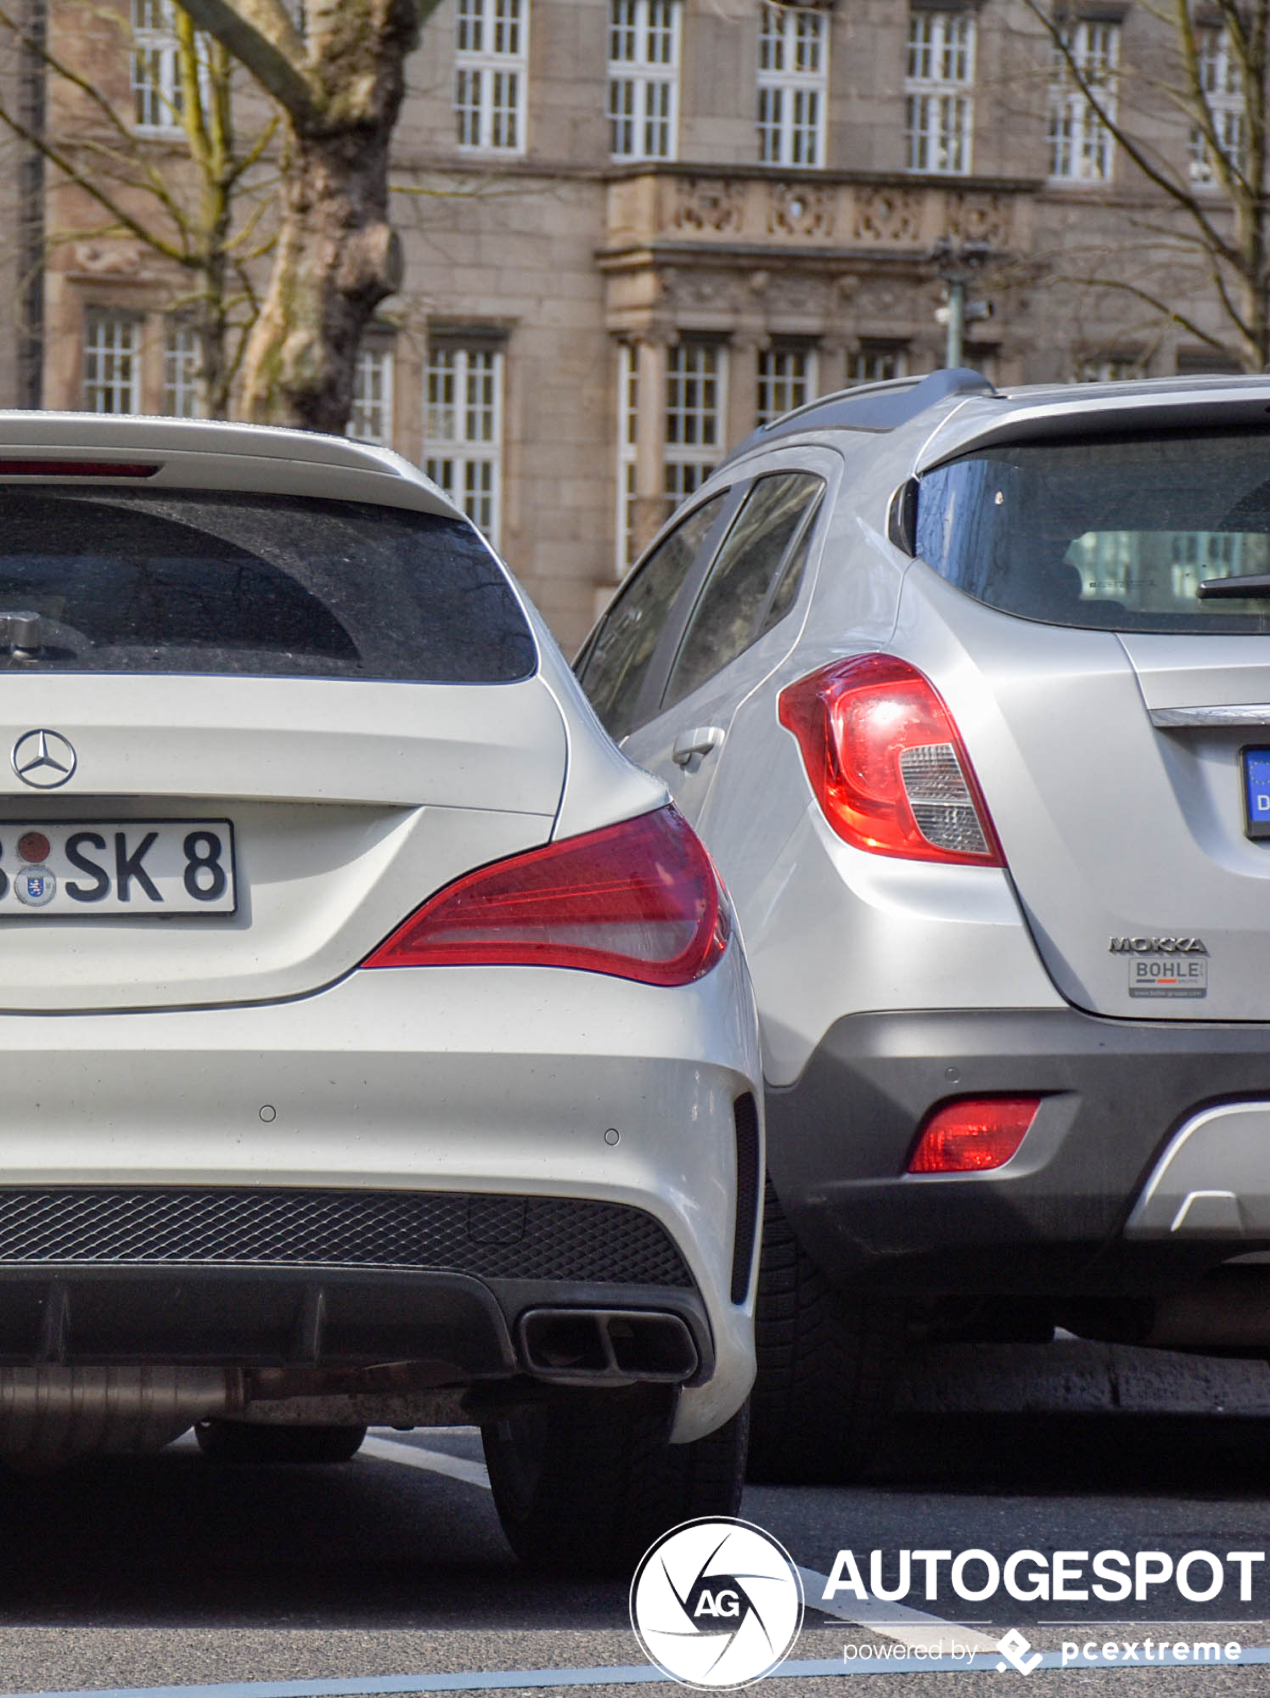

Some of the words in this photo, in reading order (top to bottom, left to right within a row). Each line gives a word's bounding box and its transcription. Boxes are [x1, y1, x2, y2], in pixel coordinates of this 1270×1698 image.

[65, 831, 165, 903] SK
[183, 831, 226, 902] 8
[1108, 936, 1208, 953] MOKKA
[1136, 962, 1200, 977] BOHLE
